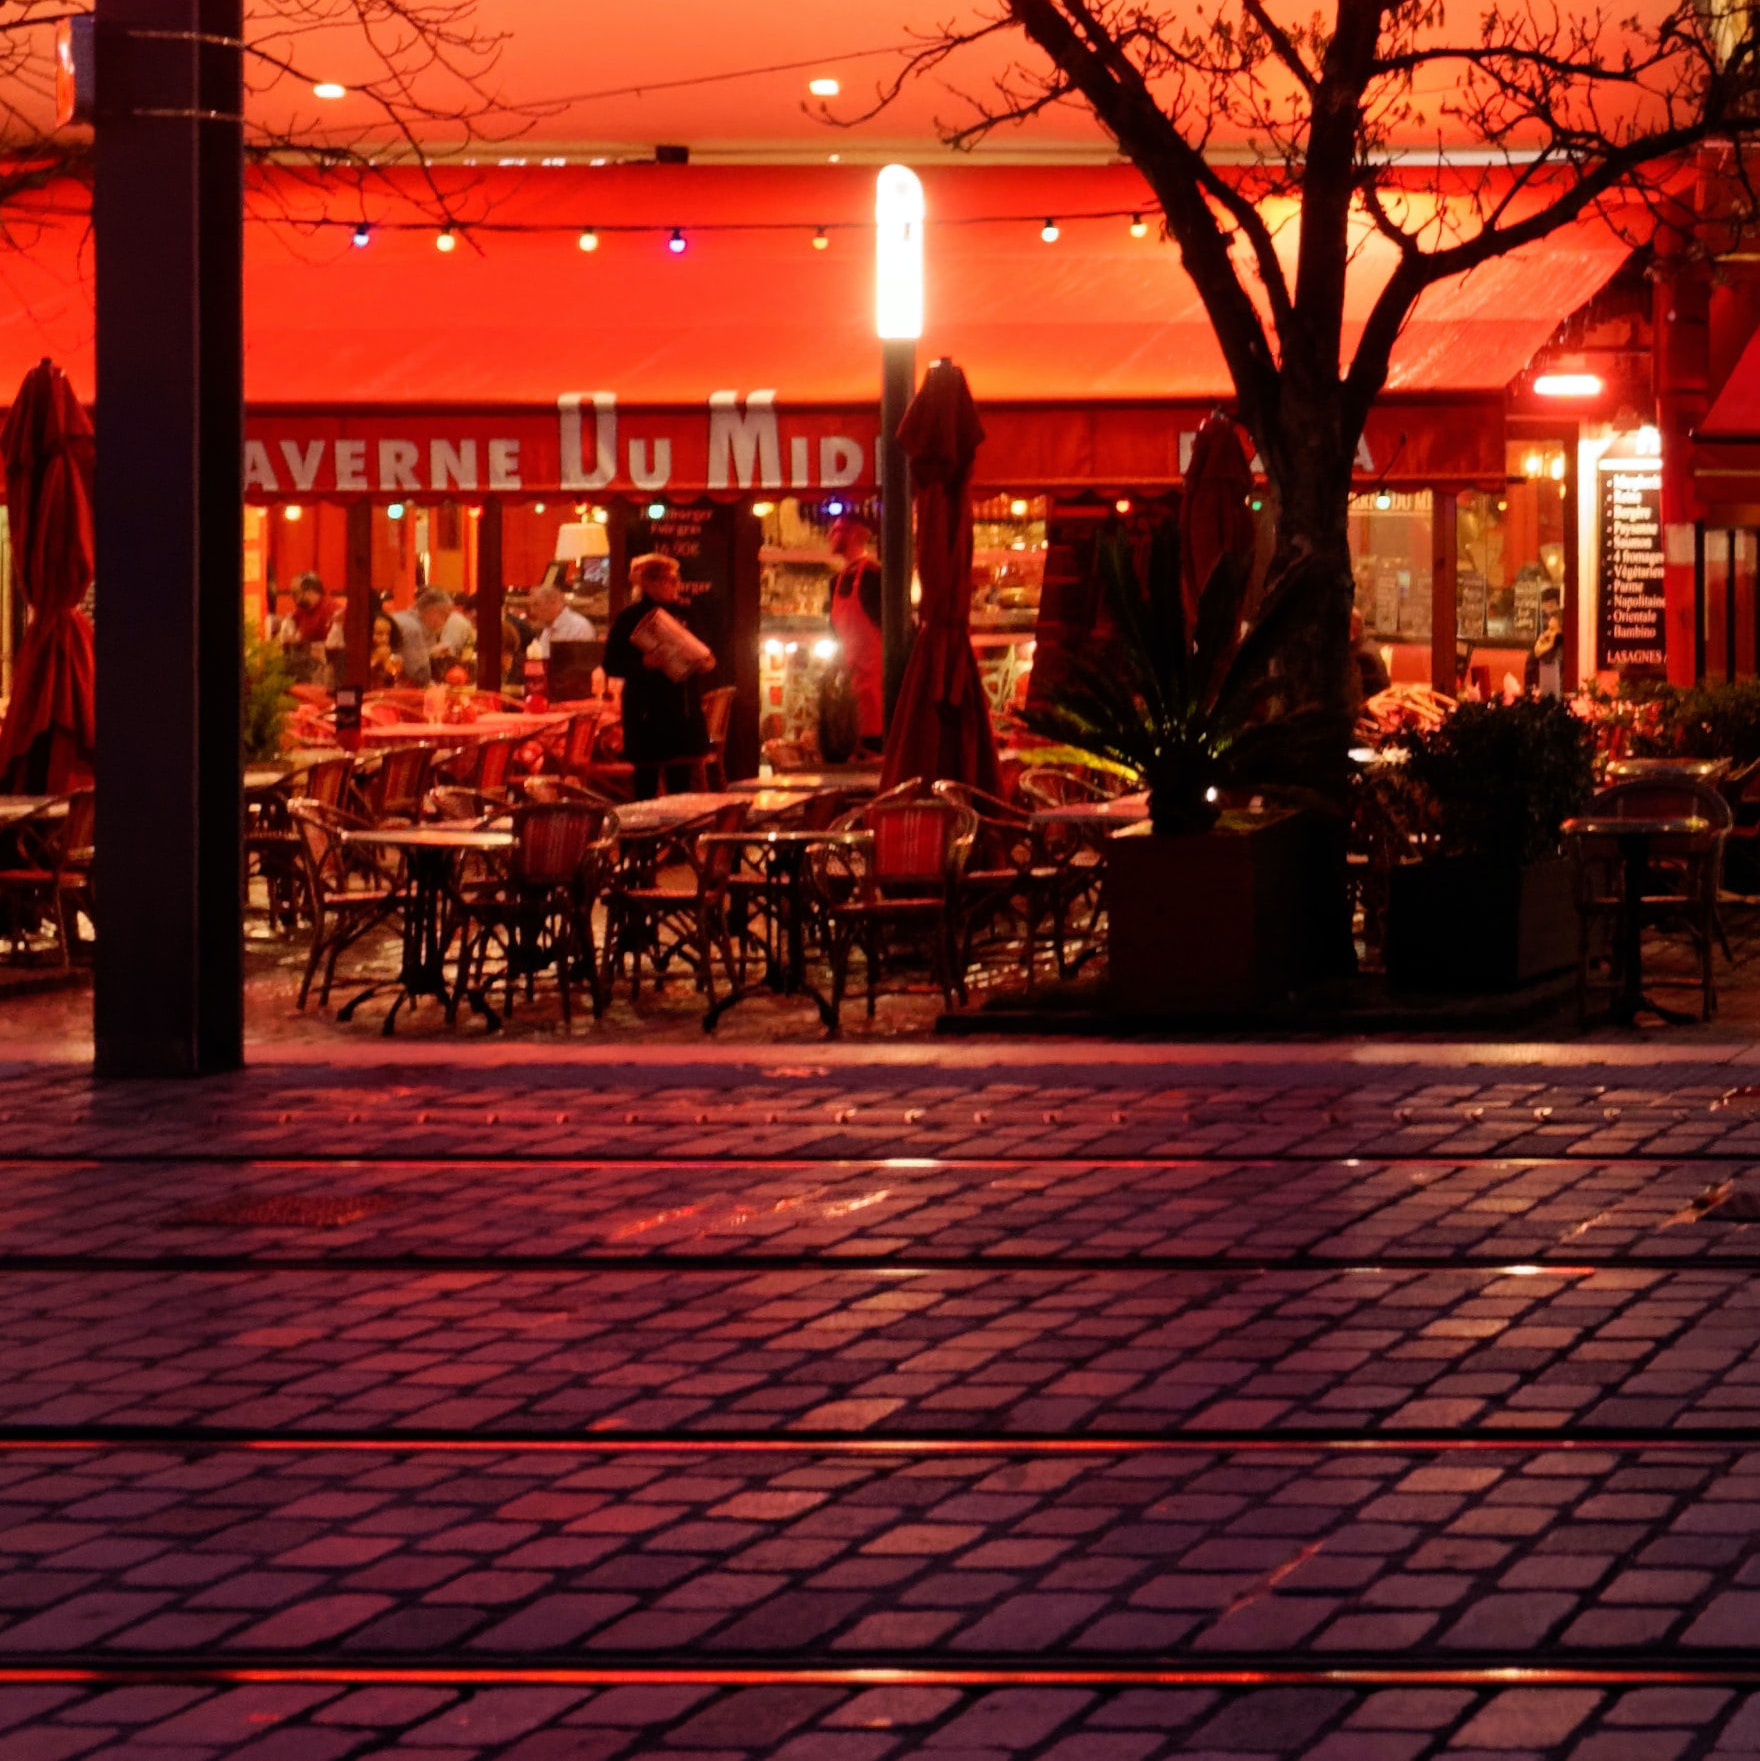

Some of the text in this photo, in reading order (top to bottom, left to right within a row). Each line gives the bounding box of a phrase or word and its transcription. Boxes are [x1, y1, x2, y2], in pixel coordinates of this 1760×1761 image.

[243, 440, 521, 490] AVERNE
[1613, 549, 1621, 563] 4
[1613, 624, 1657, 638] Bambino
[1606, 650, 1662, 664] LASAGNES
